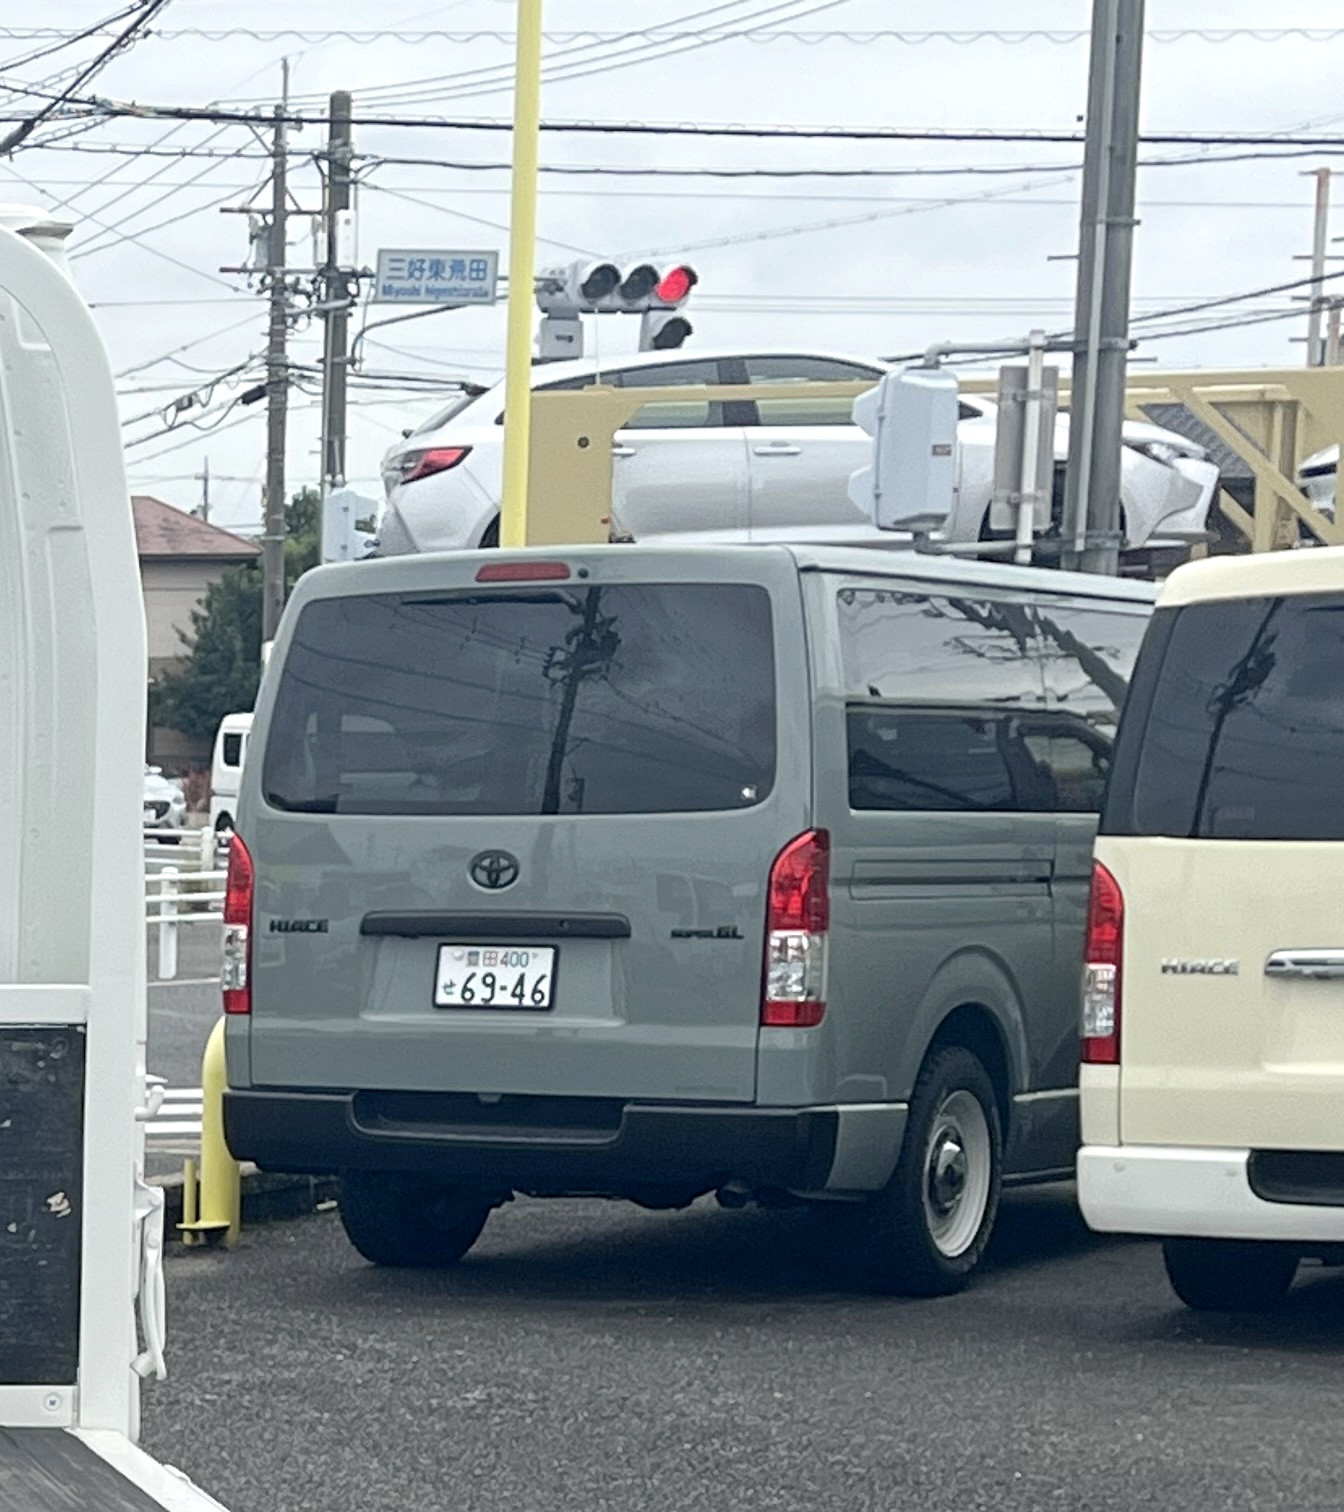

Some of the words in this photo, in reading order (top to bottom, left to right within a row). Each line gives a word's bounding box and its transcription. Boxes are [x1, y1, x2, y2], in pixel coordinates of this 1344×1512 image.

[386, 258, 488, 281] 三好東荒田
[270, 919, 329, 934] HIACE
[500, 951, 529, 968] 400
[1161, 957, 1239, 975] HIACE
[461, 972, 547, 1006] 69-46
